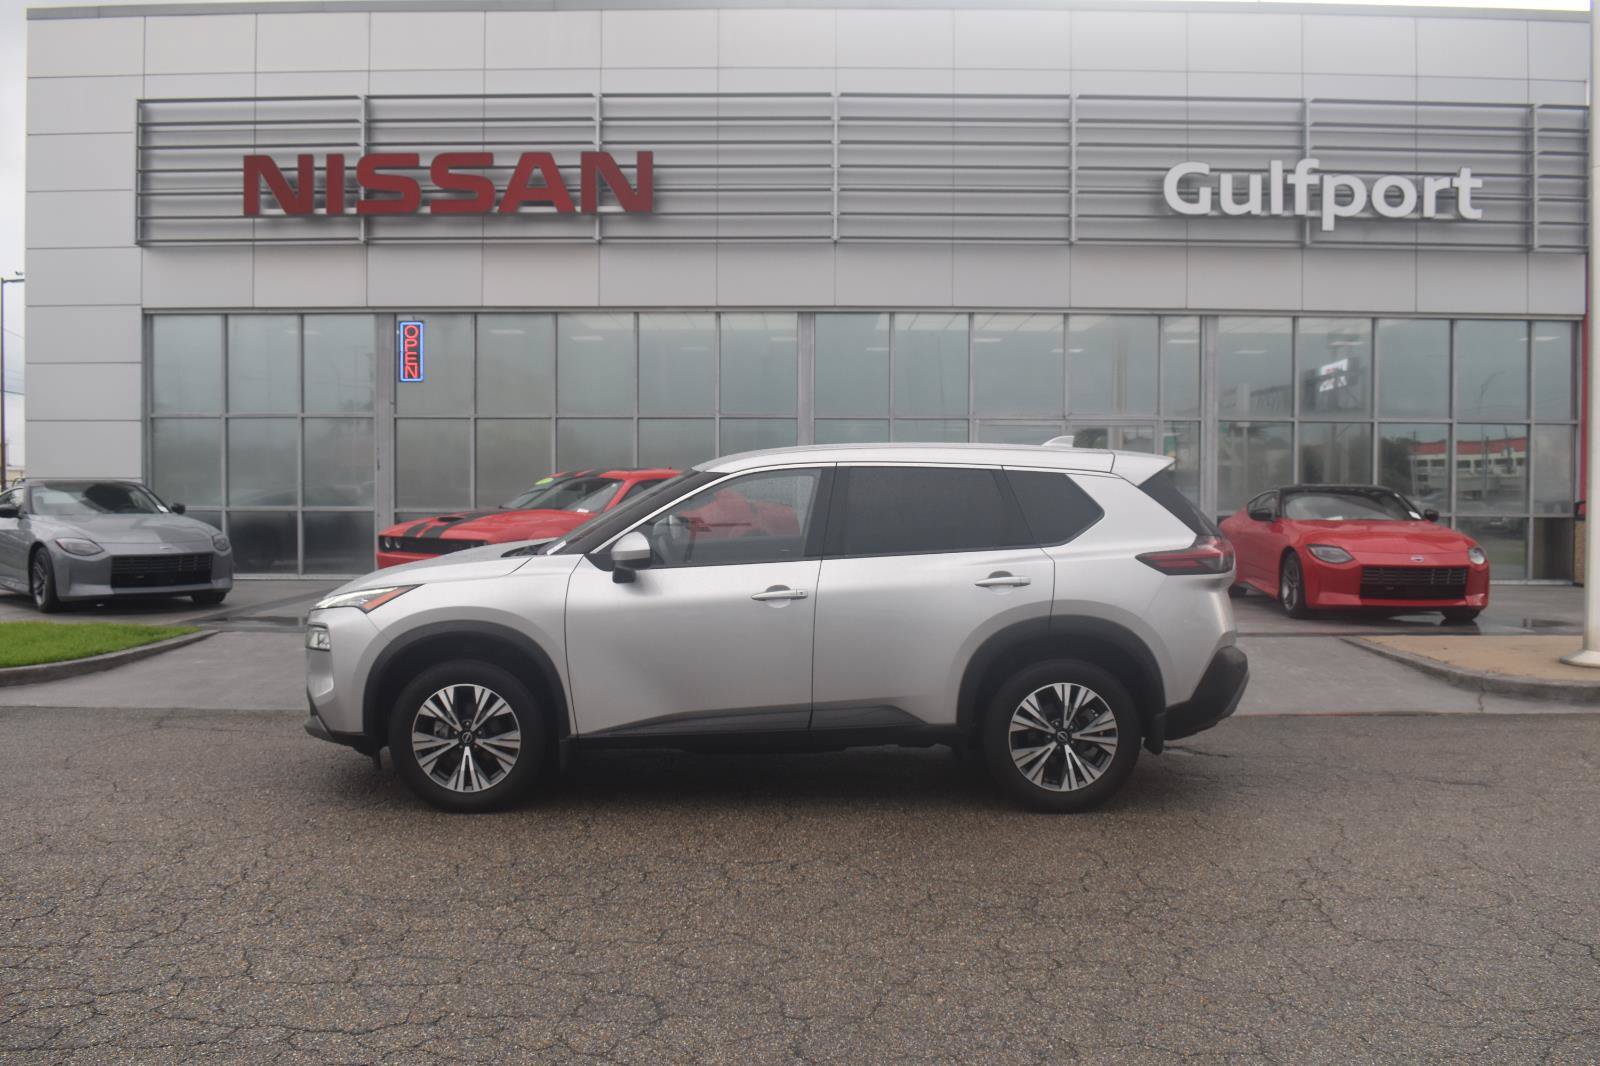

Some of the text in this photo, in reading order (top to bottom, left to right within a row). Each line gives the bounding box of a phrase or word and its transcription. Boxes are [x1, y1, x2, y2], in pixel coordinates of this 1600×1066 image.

[243, 150, 653, 216] NISSAN
[1163, 158, 1483, 231] Gulfport
[404, 325, 419, 379] OPEN
